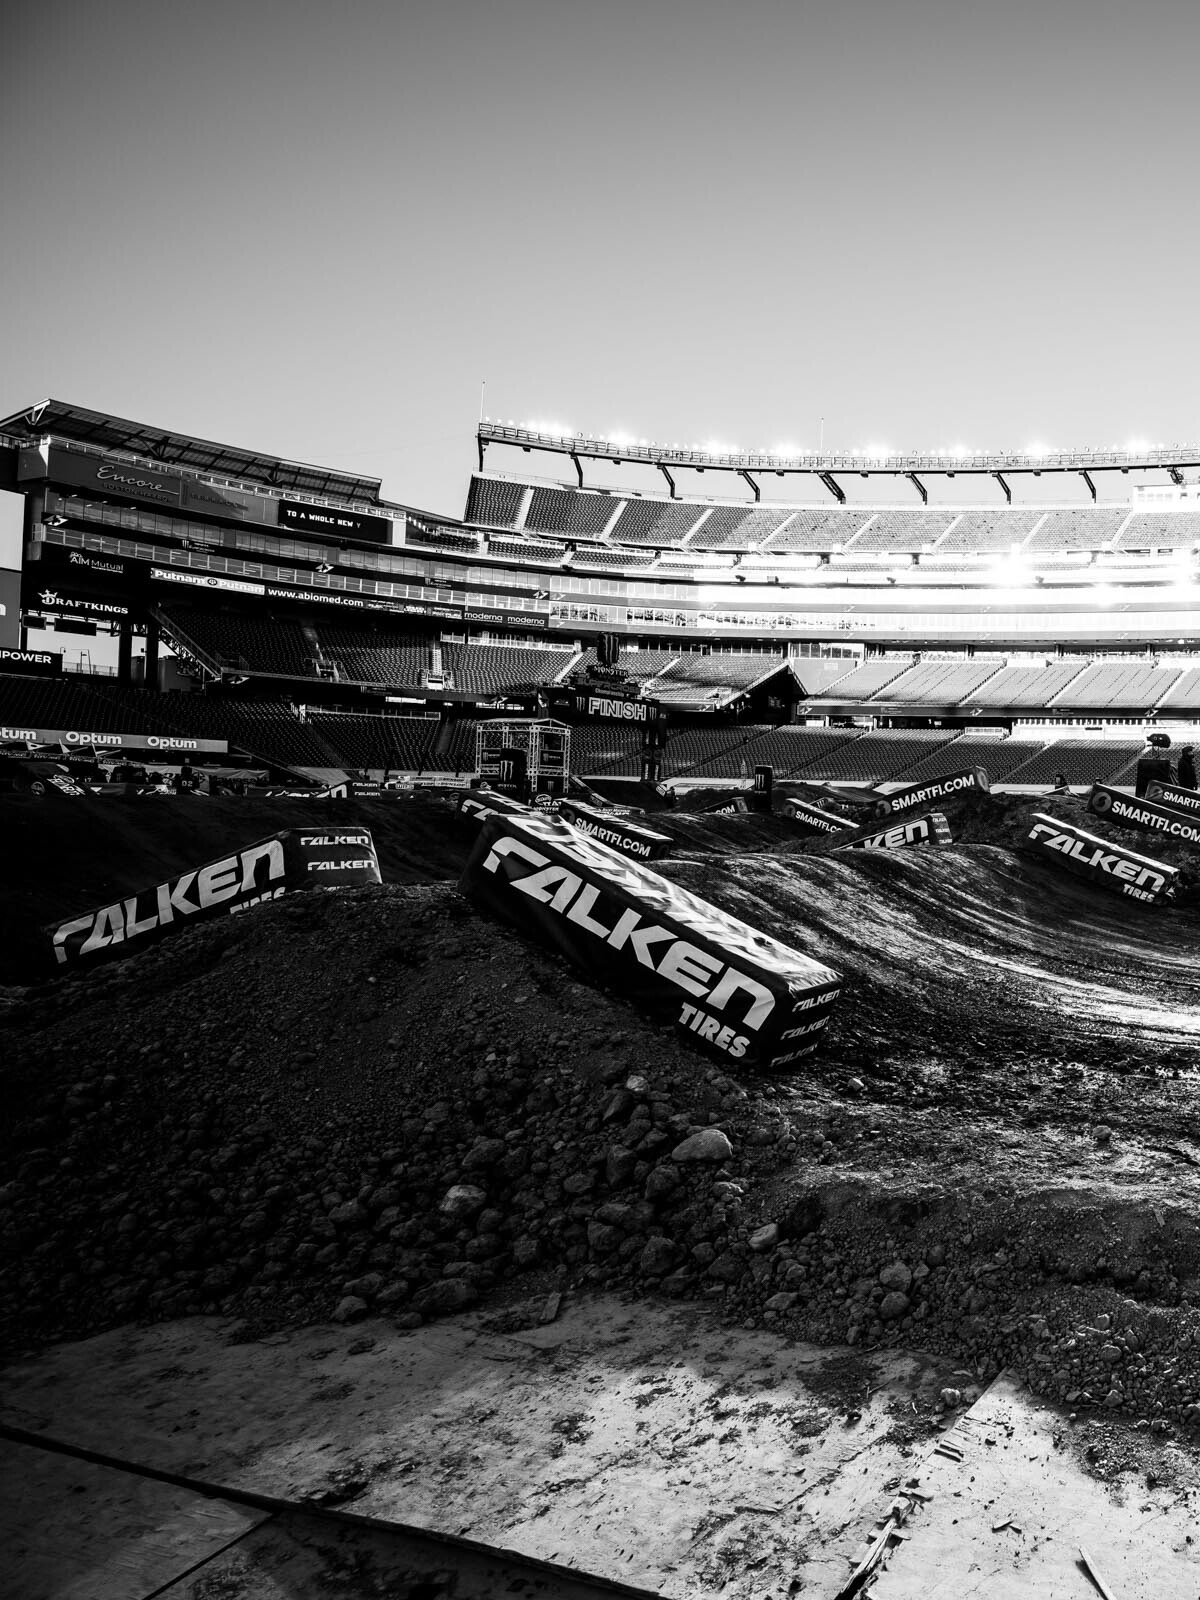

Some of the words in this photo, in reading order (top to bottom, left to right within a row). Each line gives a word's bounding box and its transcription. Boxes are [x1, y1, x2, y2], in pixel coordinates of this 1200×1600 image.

[97, 465, 179, 495] Encore
[287, 510, 297, 518] TO
[309, 514, 335, 525] WHOLE
[337, 518, 354, 527] NEW
[91, 559, 124, 571] Mutual
[154, 570, 206, 586] Putnam
[219, 580, 264, 594] Putnam
[268, 587, 364, 607] www.abiomed.com
[464, 611, 503, 622] moderna
[508, 616, 545, 625] moderna
[0, 650, 52, 664] POWER
[588, 697, 647, 721] FINISH
[66, 731, 122, 745] Optum
[147, 736, 197, 748] Optum
[891, 774, 975, 811] SMARTFI.COM
[300, 835, 369, 846] FALKEN
[575, 816, 652, 858] SMARTFI.COM
[307, 860, 375, 871] FALKEN
[1029, 823, 1165, 893] FALKEN
[53, 839, 286, 964] FALKEN
[1123, 883, 1156, 904] TIRES
[482, 836, 776, 1031] FALKEN
[792, 989, 841, 1012] FALKEN
[677, 1001, 751, 1058] TIRES
